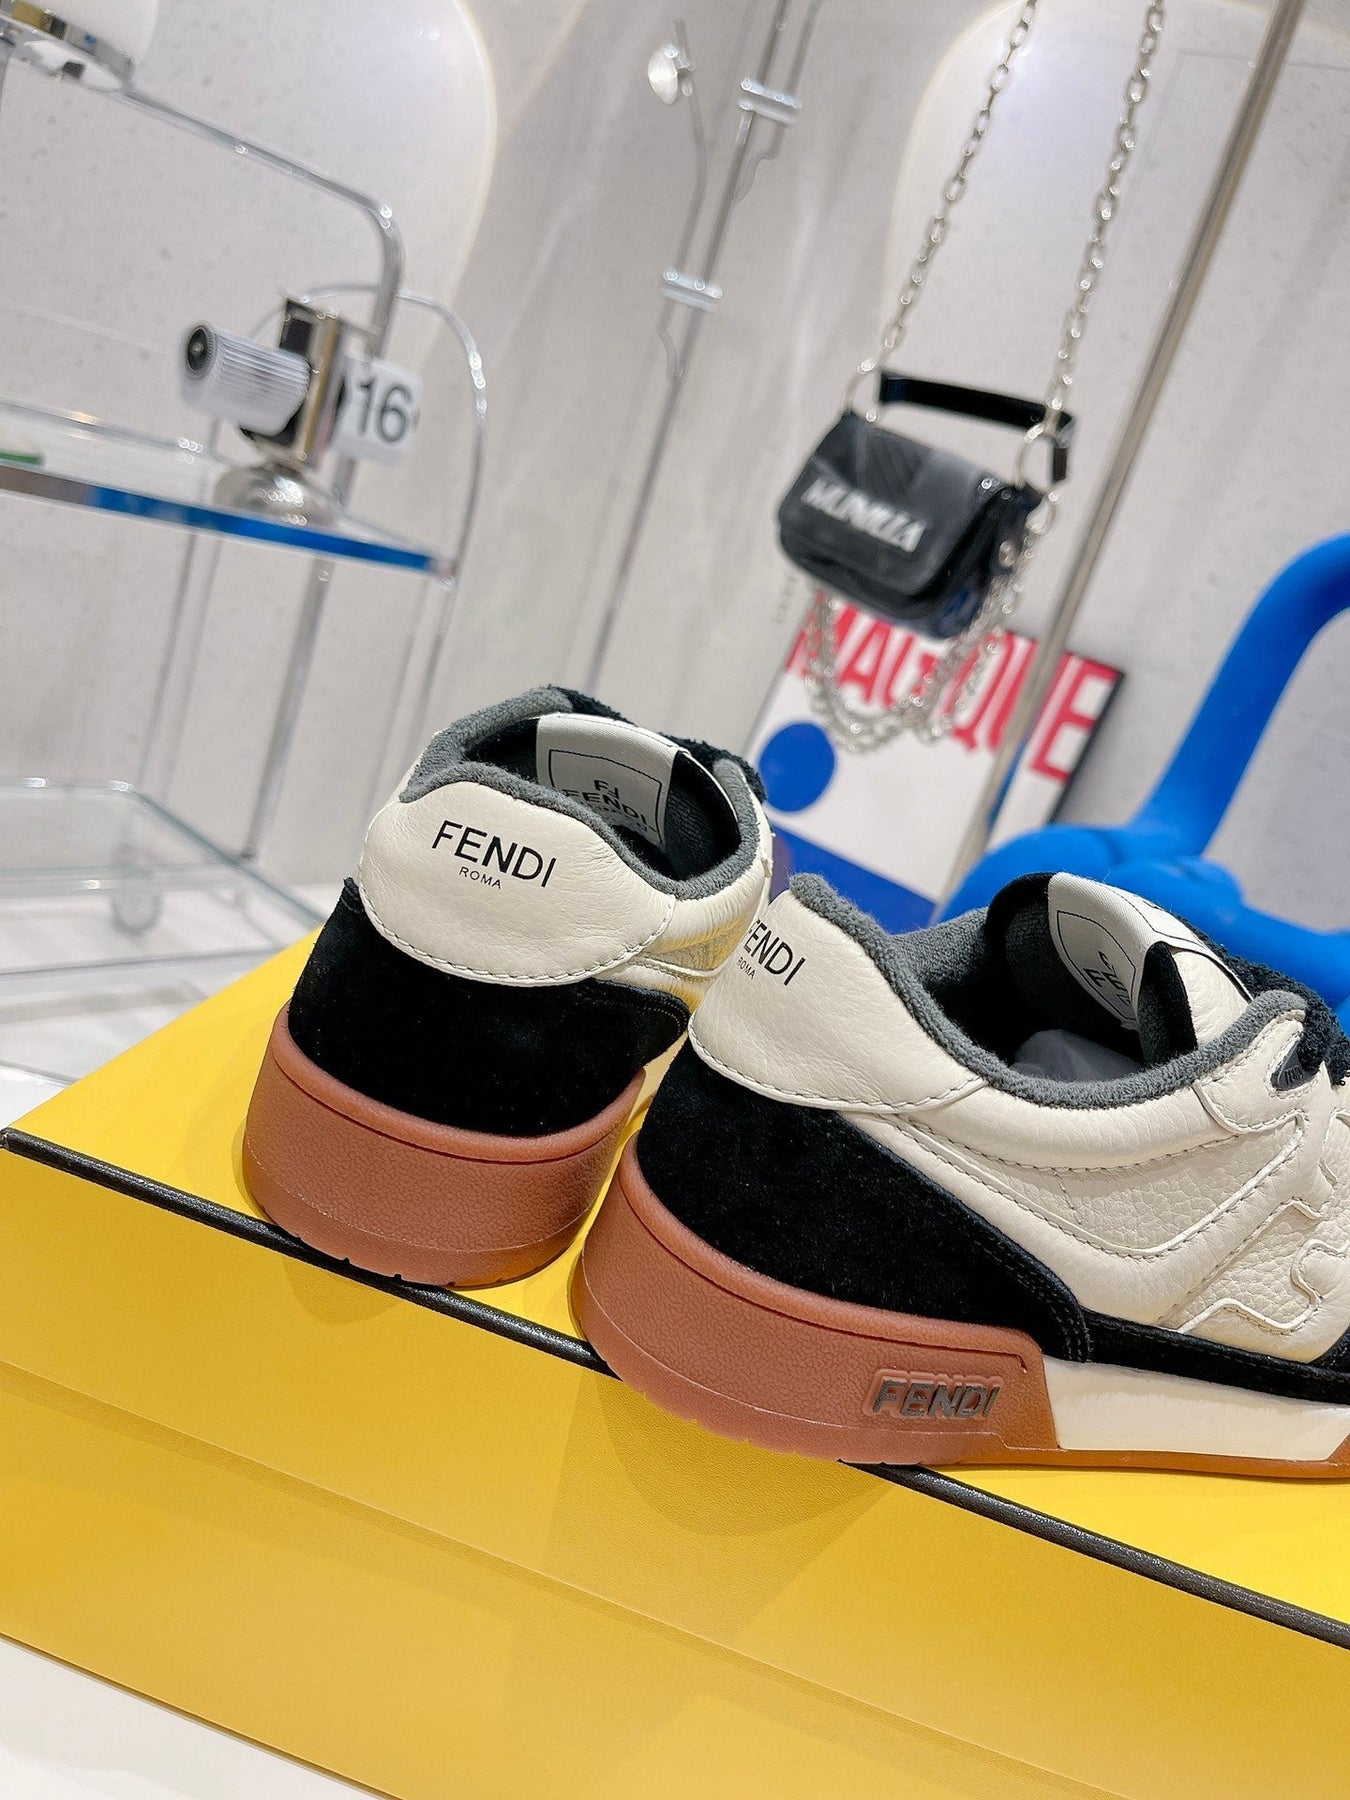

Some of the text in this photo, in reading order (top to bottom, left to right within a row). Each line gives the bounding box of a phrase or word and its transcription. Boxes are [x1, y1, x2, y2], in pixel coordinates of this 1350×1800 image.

[358, 376, 414, 442] 16
[431, 820, 557, 888] FENDI
[459, 866, 502, 889] ROMA
[872, 1378, 1001, 1418] FENDI
